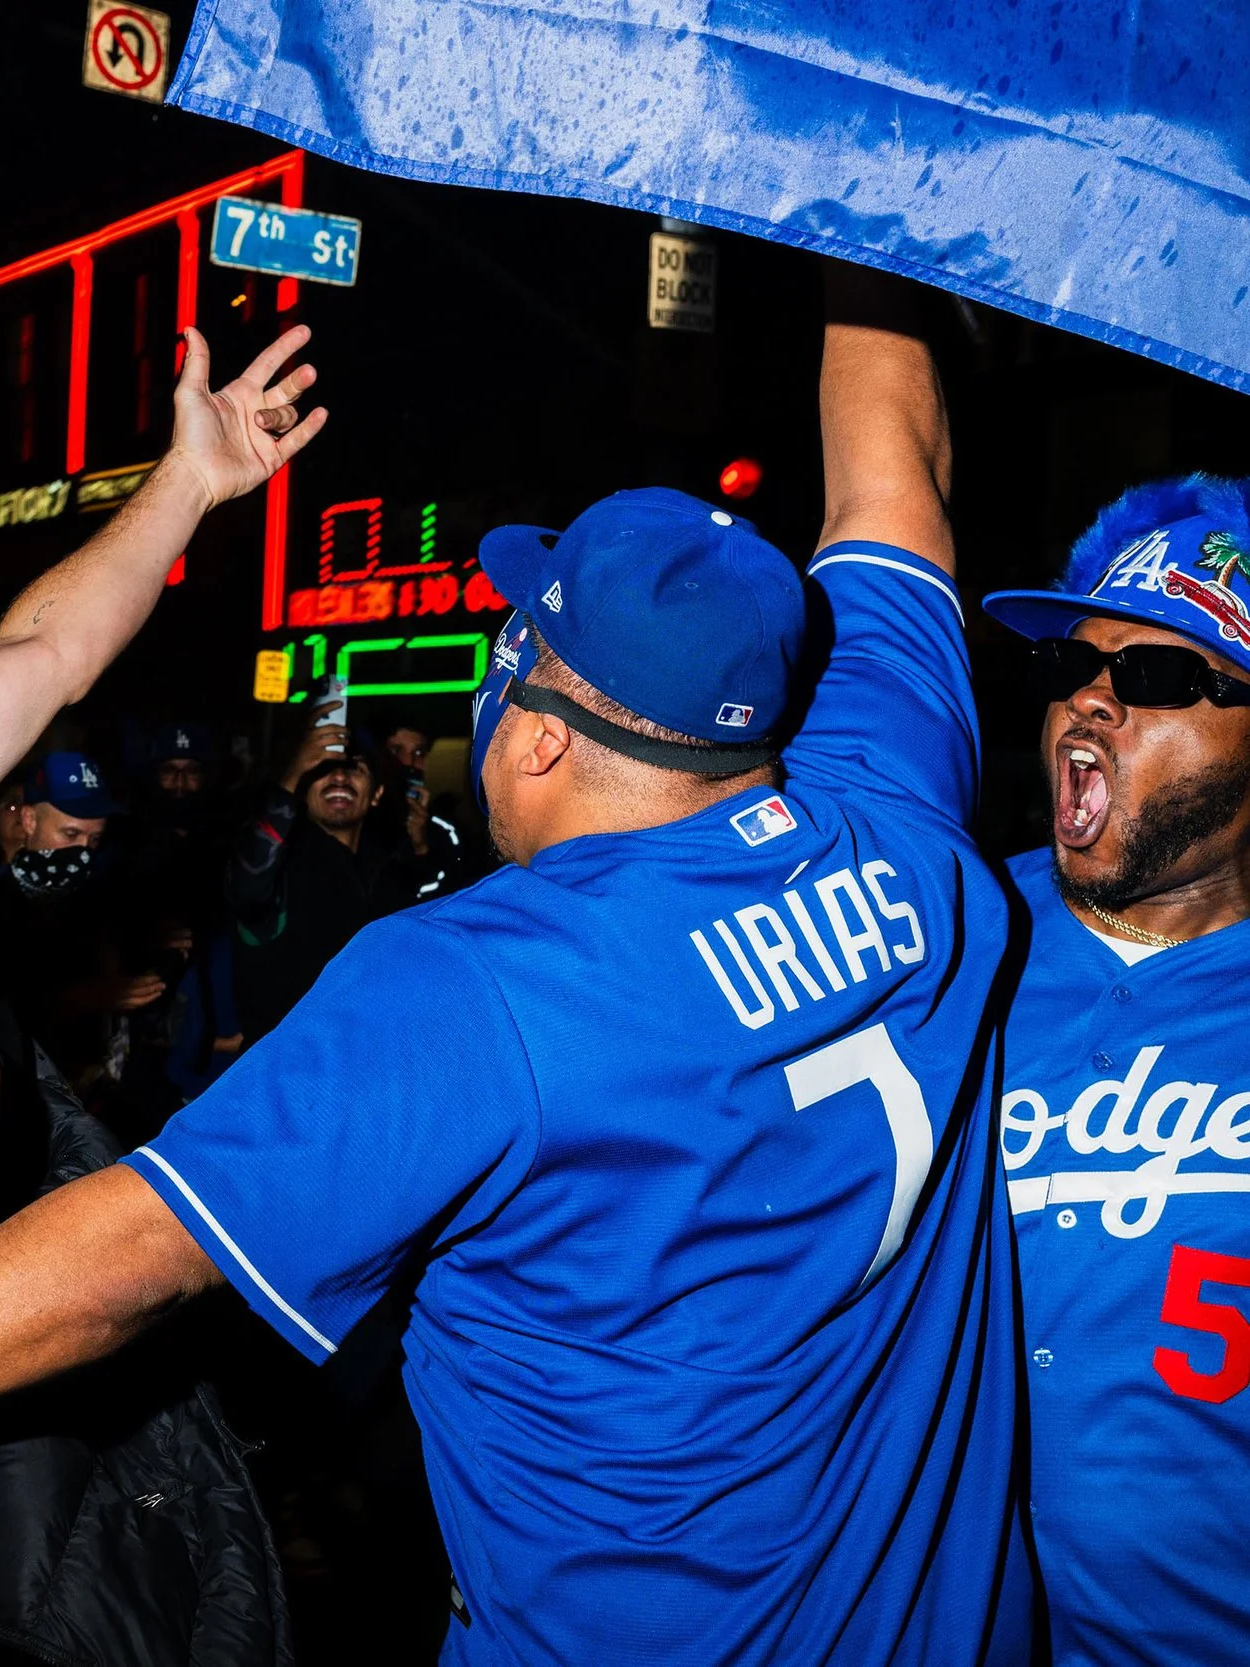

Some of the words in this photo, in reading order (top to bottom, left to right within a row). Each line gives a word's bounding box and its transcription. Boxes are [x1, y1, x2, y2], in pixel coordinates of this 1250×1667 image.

[227, 206, 286, 257] 7th
[658, 247, 680, 271] DO
[657, 278, 712, 305] BLOCK
[494, 632, 523, 672] Dodgers
[79, 761, 100, 789] LA
[689, 859, 926, 1031] URÍAS
[784, 1022, 933, 1296] 7
[1152, 1244, 1250, 1405] 5
